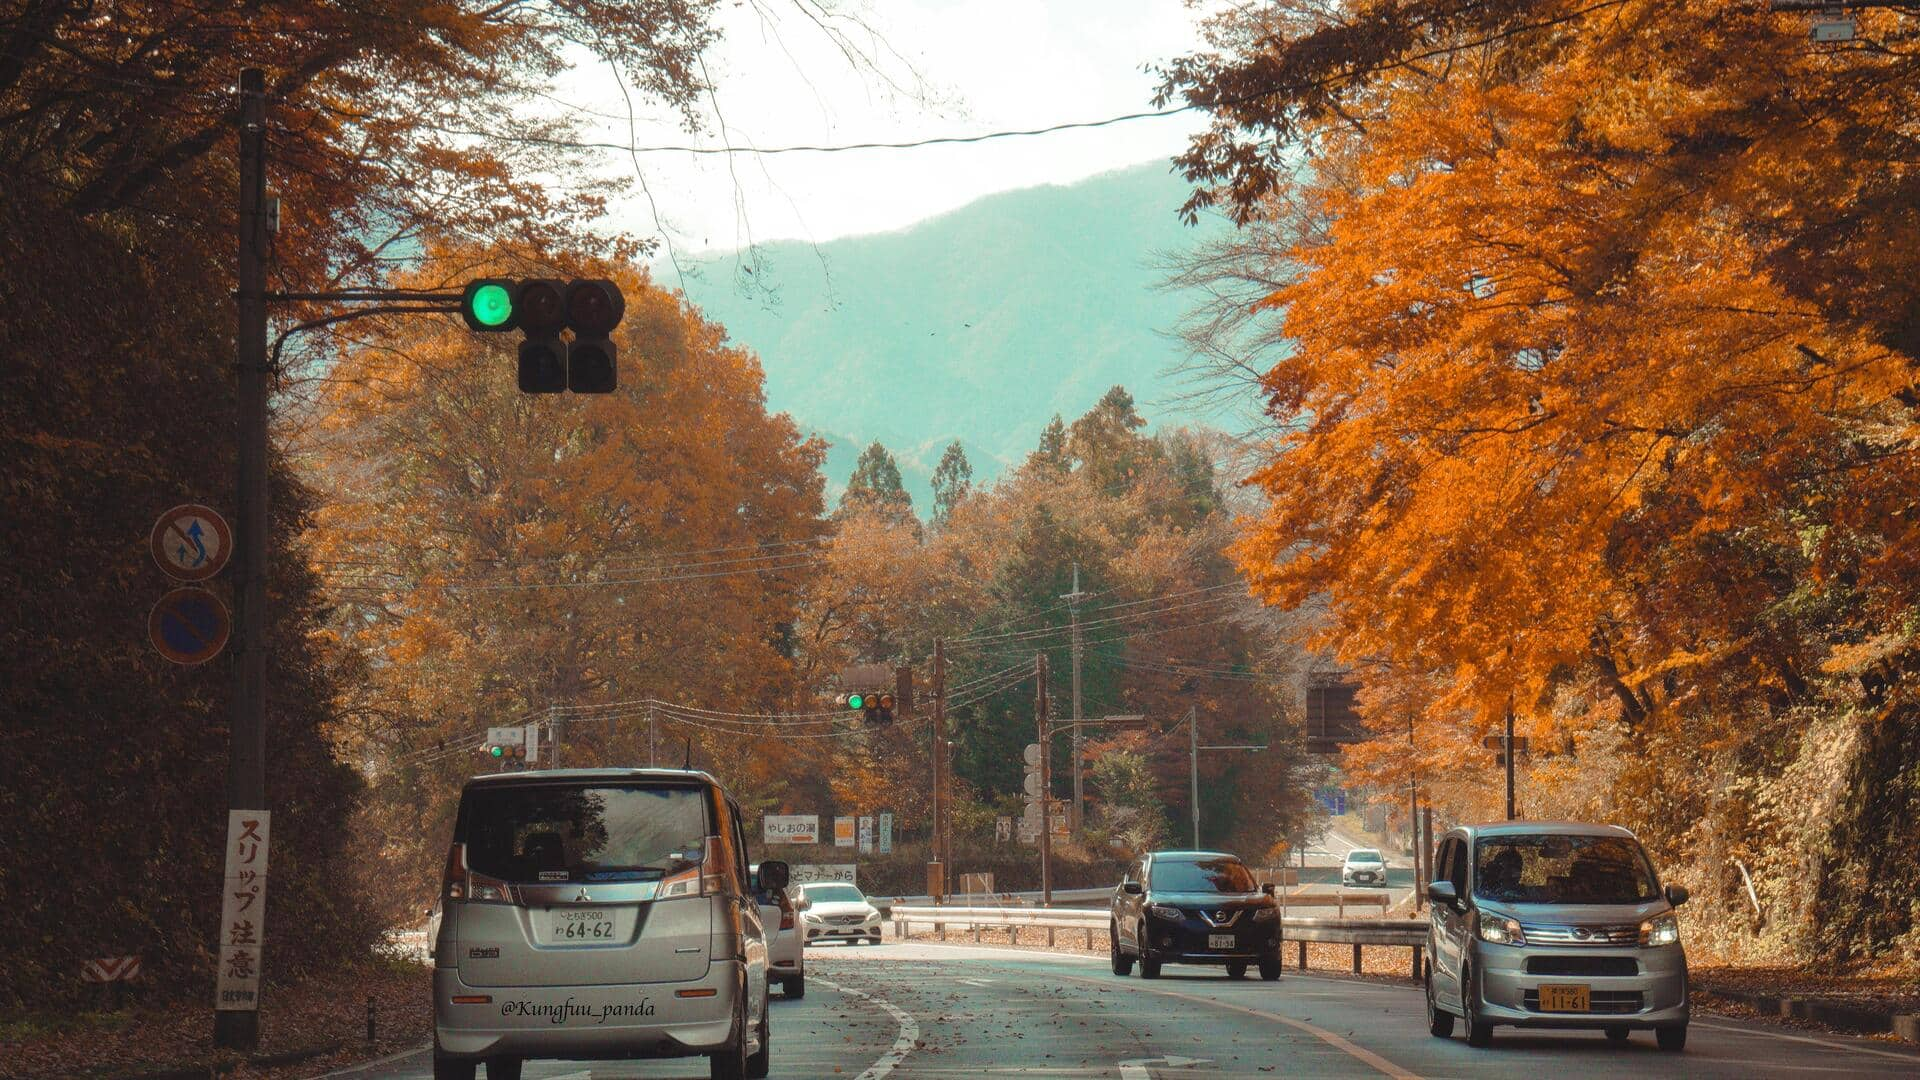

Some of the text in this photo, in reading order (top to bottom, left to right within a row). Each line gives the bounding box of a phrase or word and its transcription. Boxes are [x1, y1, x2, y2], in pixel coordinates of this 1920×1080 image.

[768, 823, 816, 833] やしおの湯
[226, 819, 262, 979] スリップ注意
[566, 922, 612, 938] 64-62
